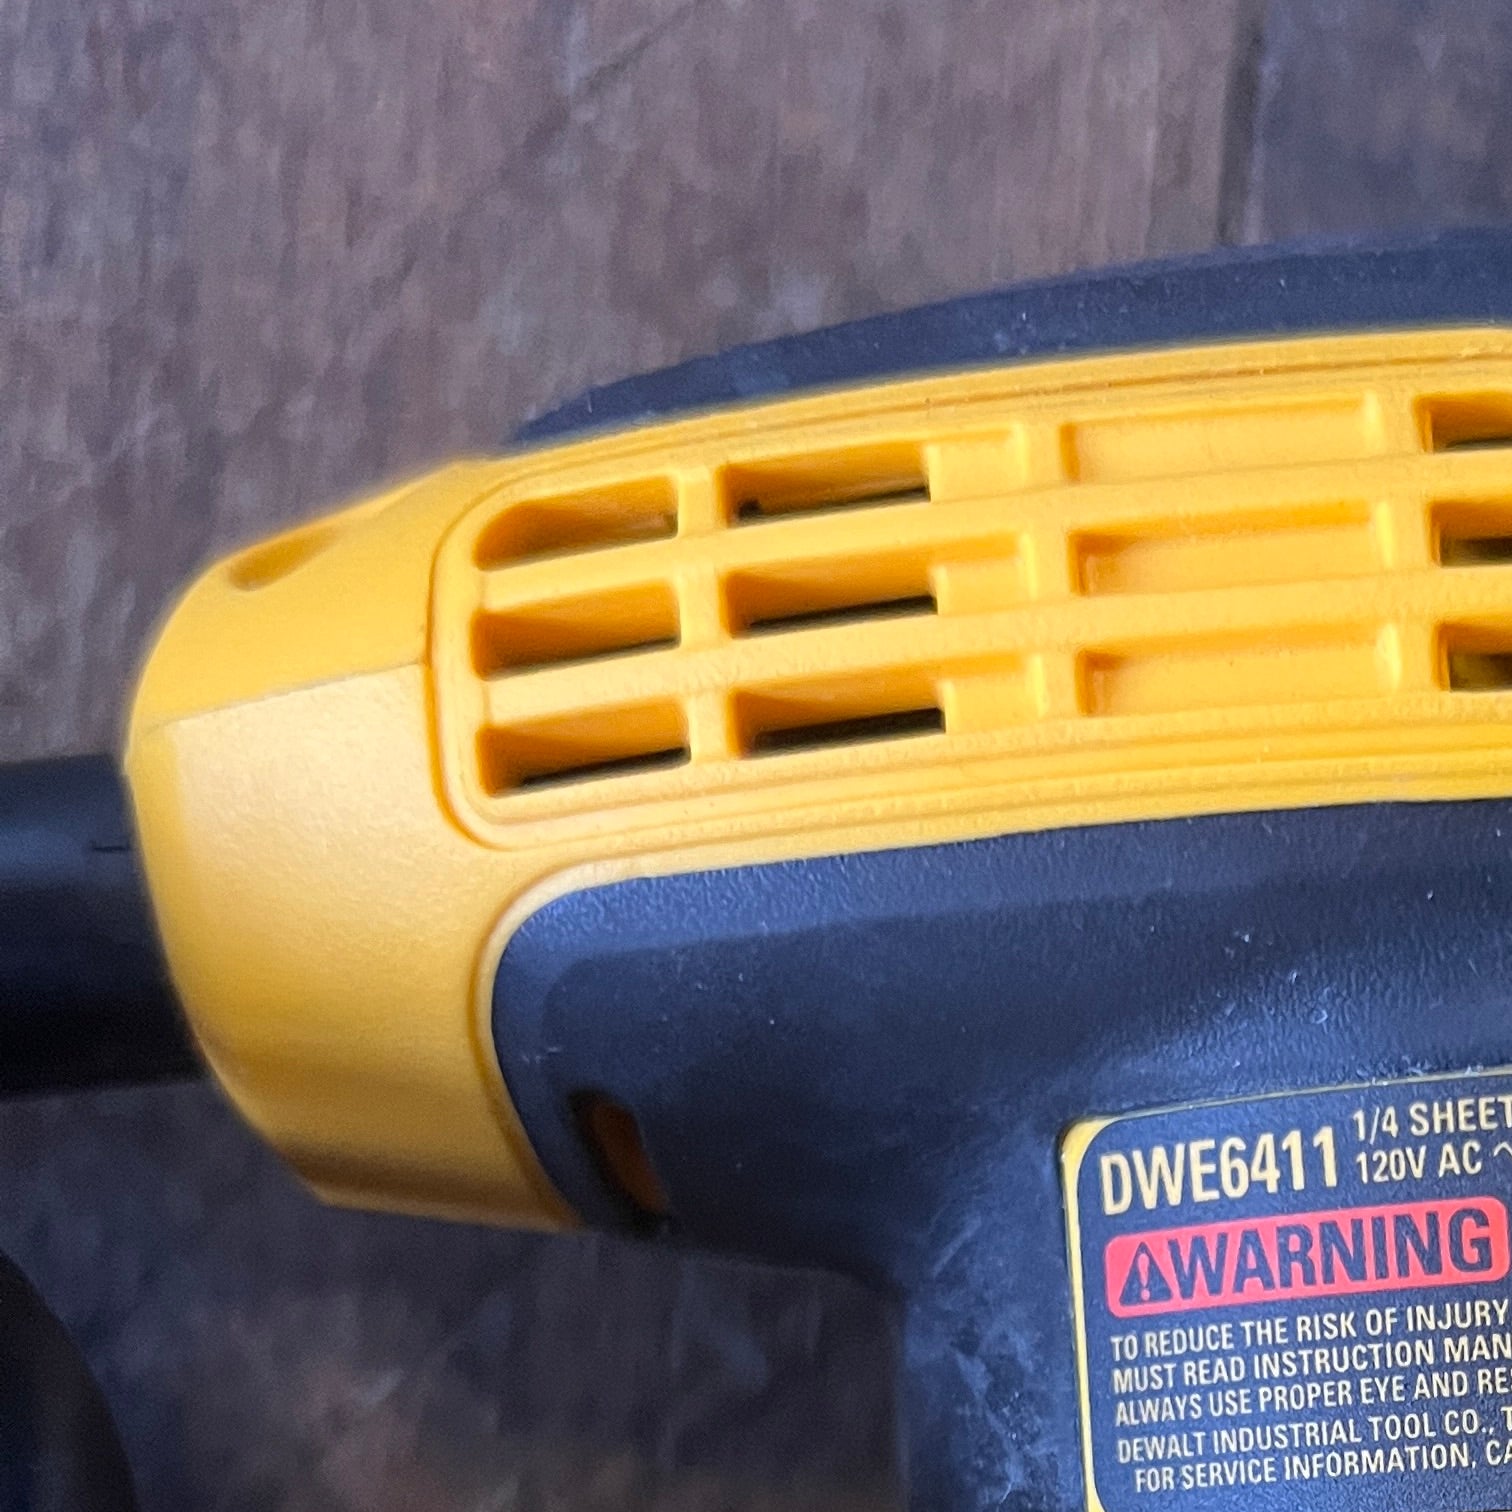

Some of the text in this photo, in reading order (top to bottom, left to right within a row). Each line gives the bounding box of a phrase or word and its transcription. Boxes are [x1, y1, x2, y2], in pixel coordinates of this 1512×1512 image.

[1353, 1106, 1399, 1145] 1/4
[1100, 1126, 1337, 1216] DWE6411
[1356, 1145, 1427, 1184] 120V
[1438, 1140, 1482, 1178] AC
[1167, 1207, 1493, 1300] WARNING
[1110, 1334, 1138, 1361] TO
[1145, 1323, 1234, 1357] REDUCE
[1240, 1317, 1288, 1347] THE
[1296, 1311, 1357, 1342] RISK
[1365, 1307, 1398, 1337] OF
[1112, 1363, 1177, 1394] MUST
[1183, 1356, 1246, 1387] READ
[1254, 1339, 1435, 1380] INSTRUCTION
[1115, 1393, 1202, 1427] ALWAYS
[1209, 1388, 1252, 1417] USE
[1259, 1380, 1353, 1412] PROPER
[1360, 1375, 1406, 1404] EYE
[1413, 1371, 1468, 1400] AND
[1117, 1431, 1206, 1464] DEWALT
[1213, 1418, 1362, 1454] INDUSTRIAL
[1368, 1413, 1436, 1442] TOOL
[1444, 1408, 1494, 1436] CO.,
[1135, 1467, 1174, 1493] FOR
[1180, 1457, 1277, 1490] SERVICE
[1284, 1442, 1476, 1481] INFORMATION,
